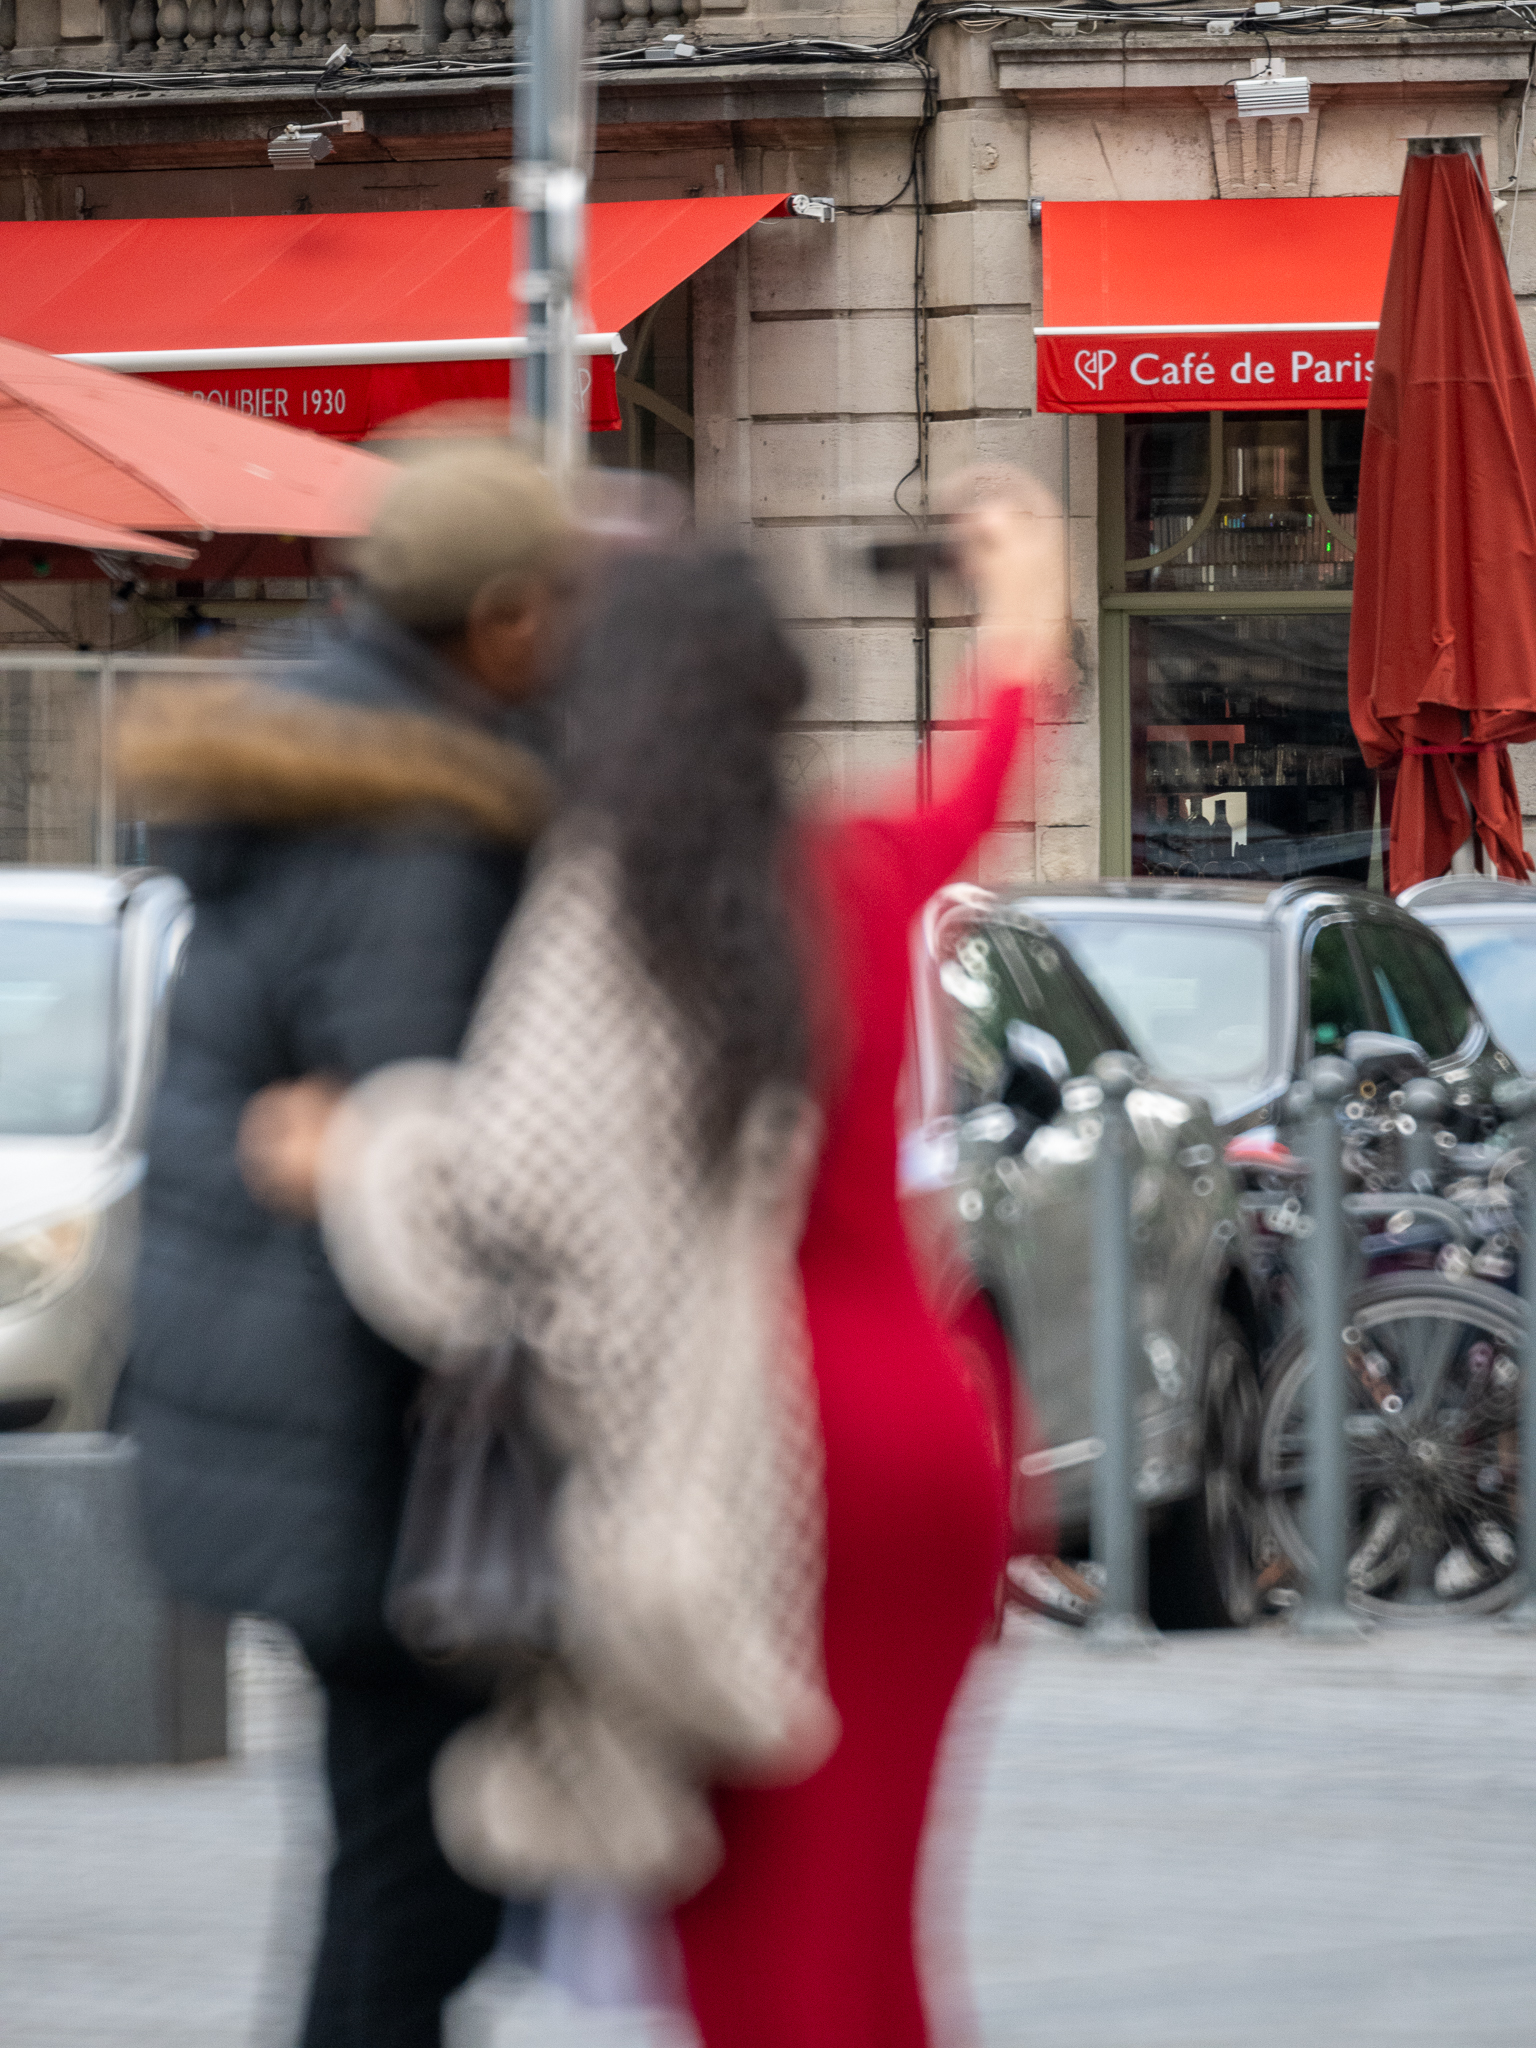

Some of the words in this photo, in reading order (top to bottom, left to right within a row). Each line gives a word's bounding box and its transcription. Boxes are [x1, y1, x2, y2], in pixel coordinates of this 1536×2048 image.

[1130, 352, 1215, 385] Café
[1230, 351, 1275, 384] de
[1291, 351, 1376, 383] Paris
[302, 388, 346, 415] 1930
